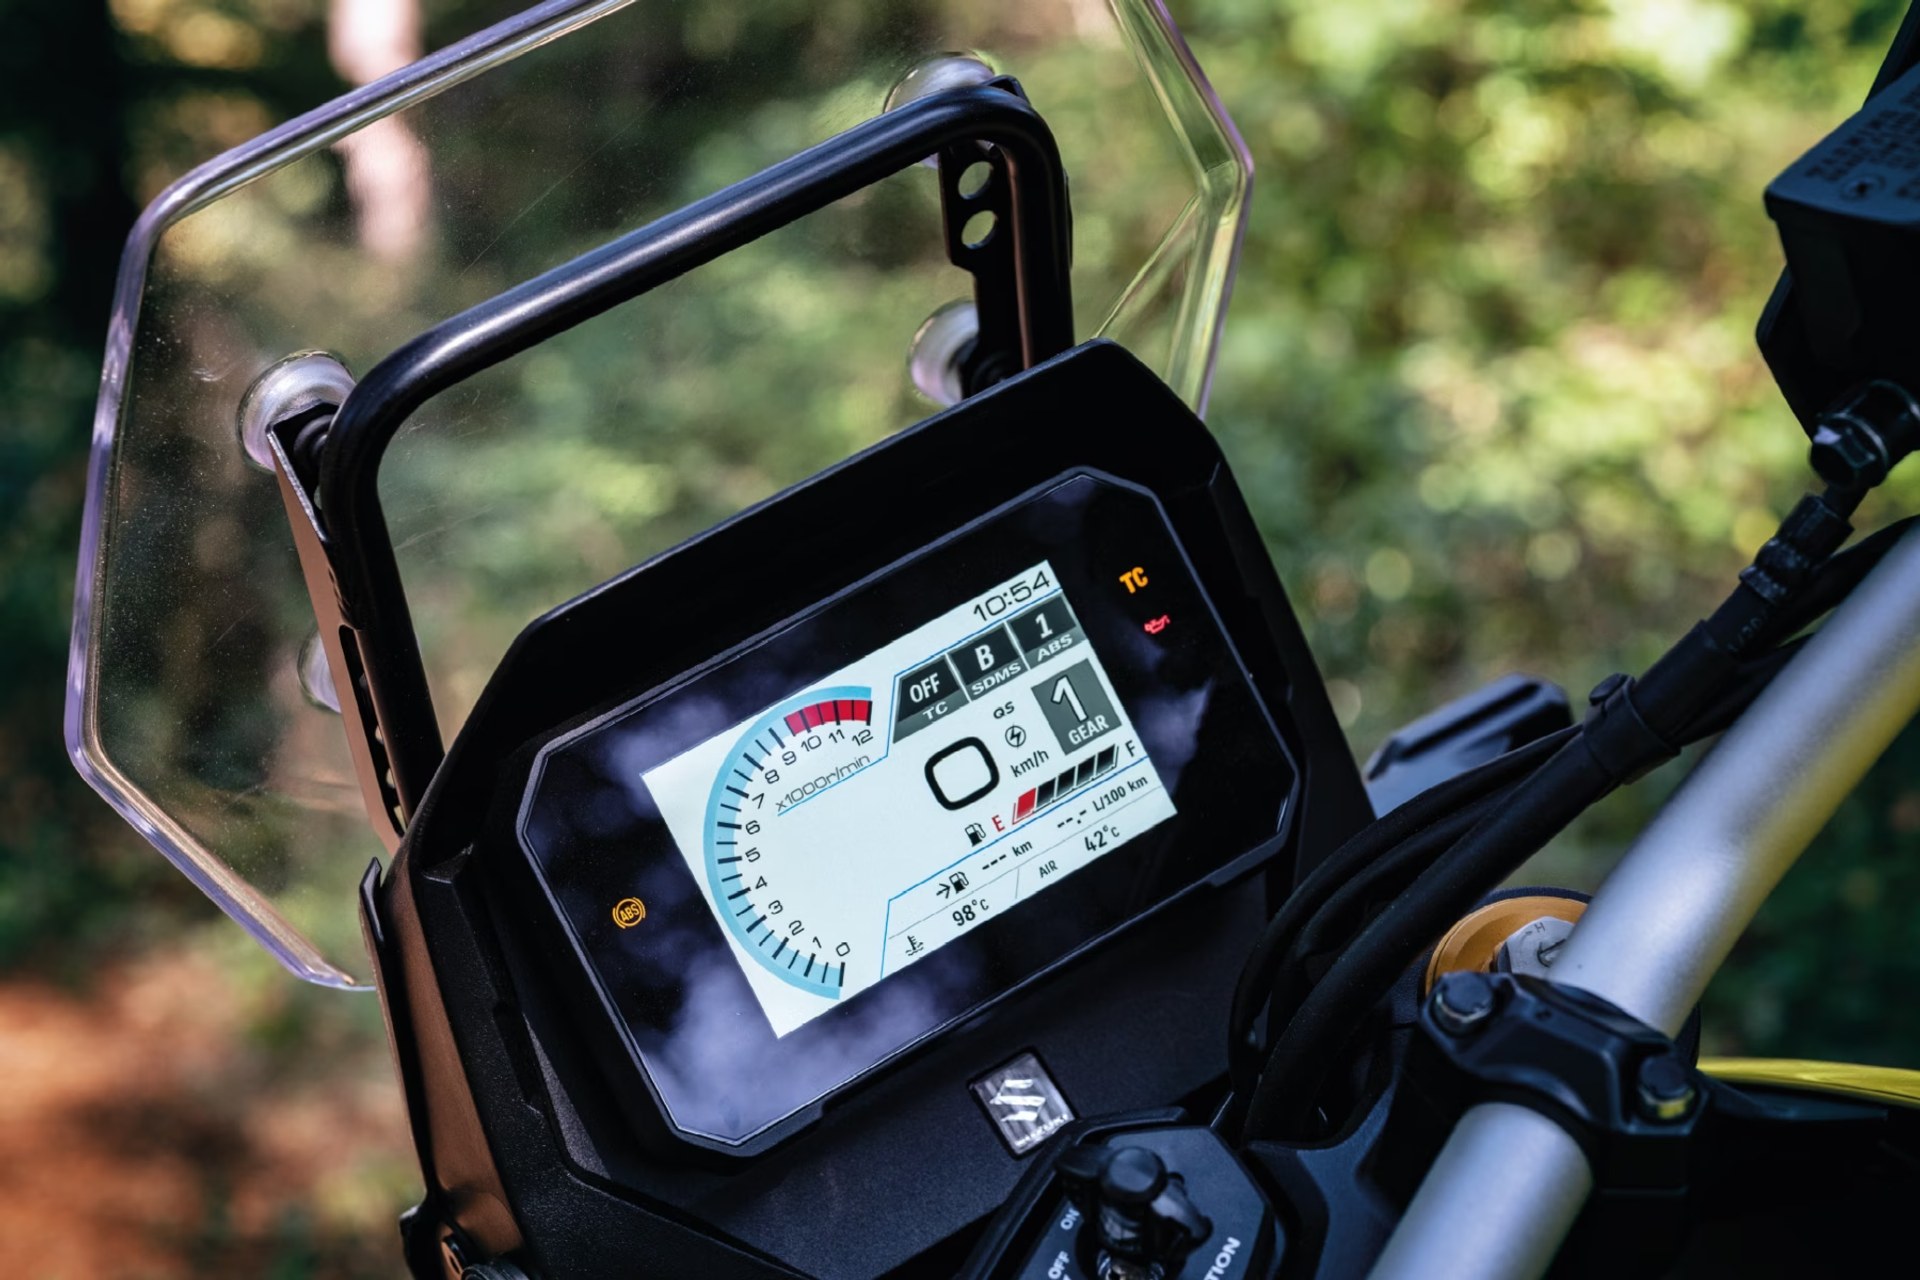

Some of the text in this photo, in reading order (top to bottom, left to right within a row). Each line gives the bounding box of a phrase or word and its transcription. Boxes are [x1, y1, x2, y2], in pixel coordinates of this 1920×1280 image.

[1120, 567, 1148, 593] TC
[973, 571, 1050, 621] 10:54
[1035, 613, 1052, 638] 1
[975, 644, 994, 670] B
[1037, 637, 1073, 661] ABS
[910, 673, 940, 703] OFF
[972, 663, 1021, 695] SDMS
[1051, 676, 1088, 722] 1
[923, 702, 948, 721] TC
[993, 702, 1015, 720] QS
[829, 729, 845, 744] 11
[852, 730, 873, 747] 12
[1068, 715, 1109, 745] GEAR
[801, 735, 822, 752] 10
[1126, 740, 1136, 757] F
[782, 751, 797, 766] 9
[1011, 748, 1049, 777] km/h
[765, 770, 780, 784] 8
[924, 737, 1000, 811] 0
[752, 793, 765, 809] 7
[1092, 786, 1126, 812] L/100
[1128, 776, 1148, 792] km
[746, 820, 761, 835] 6
[992, 815, 1005, 832] E
[746, 848, 761, 862] 5
[1012, 840, 1033, 856] km
[1038, 860, 1058, 878] AIR
[755, 876, 767, 889] 4
[620, 903, 640, 922] ABS
[769, 900, 783, 914] 3
[789, 920, 804, 935] 2
[812, 936, 822, 948] 1
[836, 942, 851, 956] 0
[1060, 1207, 1080, 1230] ON
[1048, 1250, 1070, 1280] OFF
